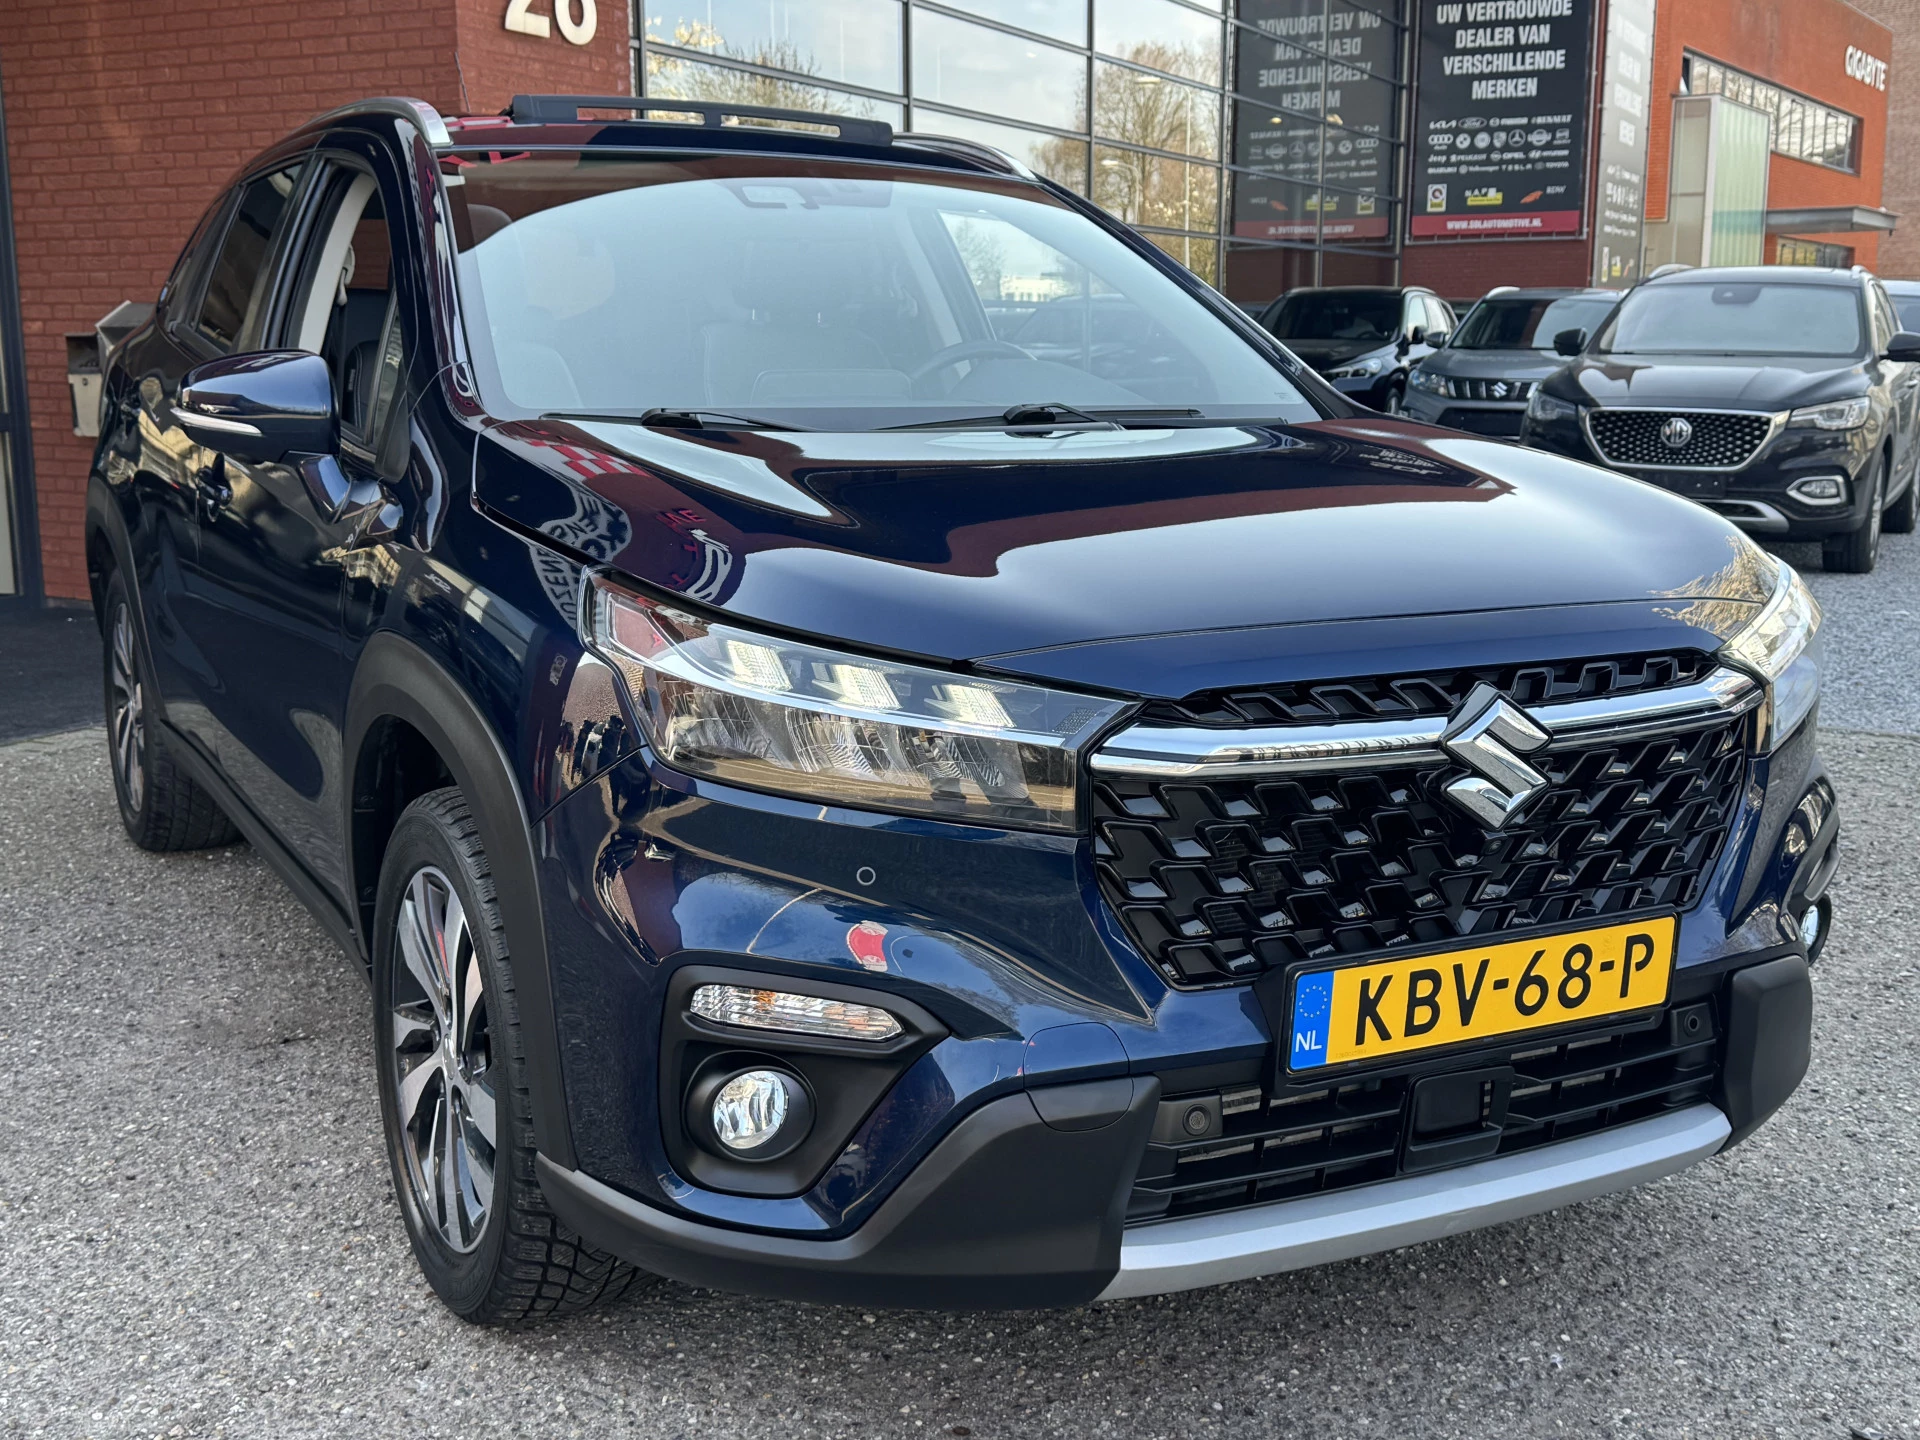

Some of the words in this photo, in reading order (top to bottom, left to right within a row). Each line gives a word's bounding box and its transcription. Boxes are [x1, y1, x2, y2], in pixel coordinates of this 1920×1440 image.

[1436, 4, 1462, 24] UW
[1466, 0, 1573, 22] VERTROUWDE
[1455, 27, 1514, 49] DEALER
[1518, 24, 1551, 45] VAN
[1443, 49, 1566, 75] VERSCHILLENDE
[1845, 45, 1888, 92] GIGABYTE
[1472, 77, 1538, 100] MERKEN
[1663, 420, 1688, 443] MG
[1355, 933, 1655, 1046] KBV-68-P
[1295, 1029, 1323, 1053] NL
